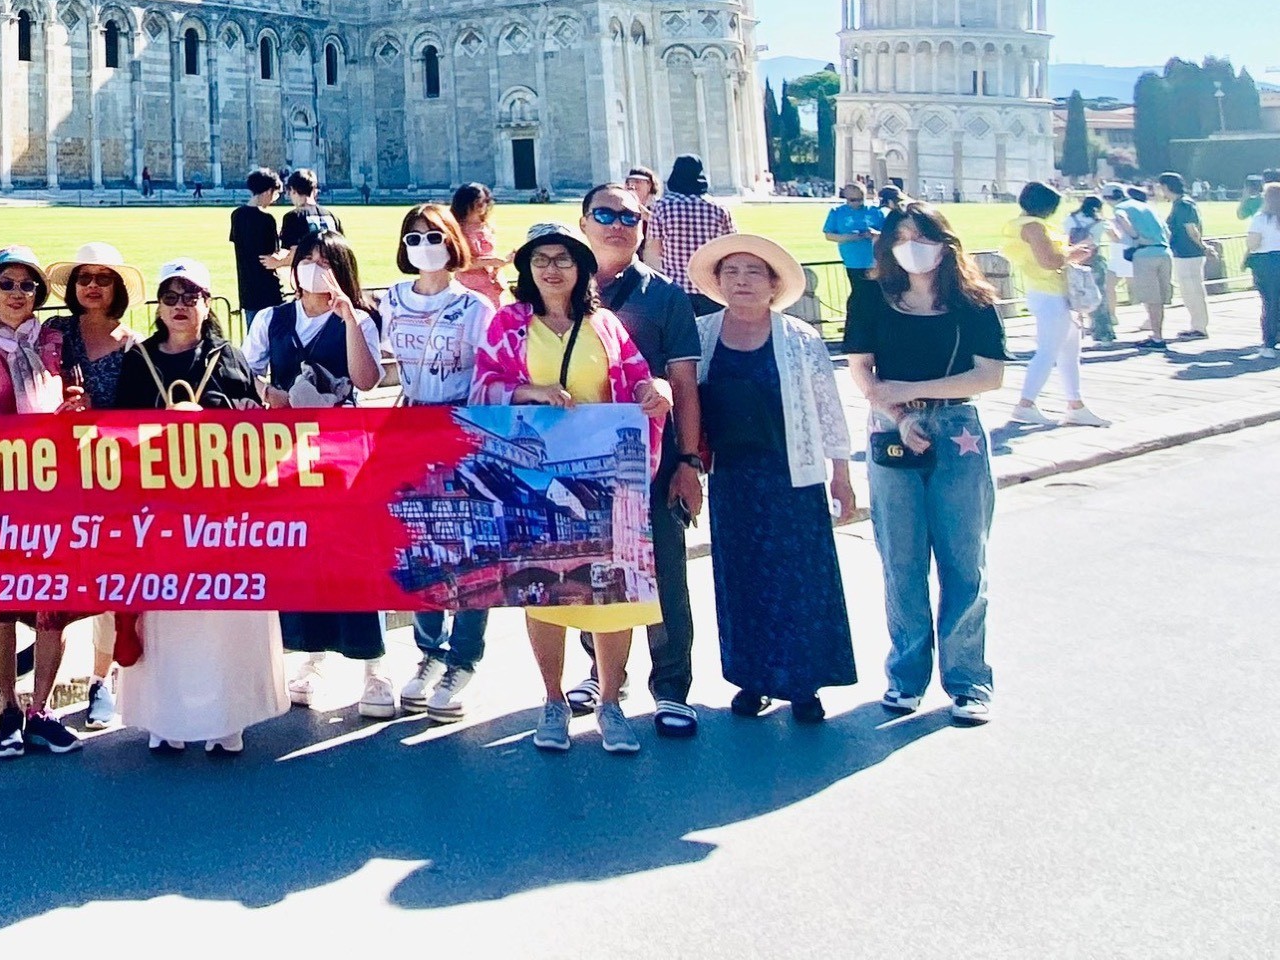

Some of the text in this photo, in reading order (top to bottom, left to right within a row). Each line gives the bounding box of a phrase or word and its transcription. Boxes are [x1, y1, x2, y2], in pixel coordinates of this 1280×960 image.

[395, 332, 456, 352] ERSCE
[73, 425, 121, 490] To
[138, 422, 325, 489] EUROPE
[69, 514, 105, 549] Sĩ
[132, 506, 155, 548] Ý
[182, 512, 308, 548] Vatican
[95, 572, 267, 605] 12/08/2023
